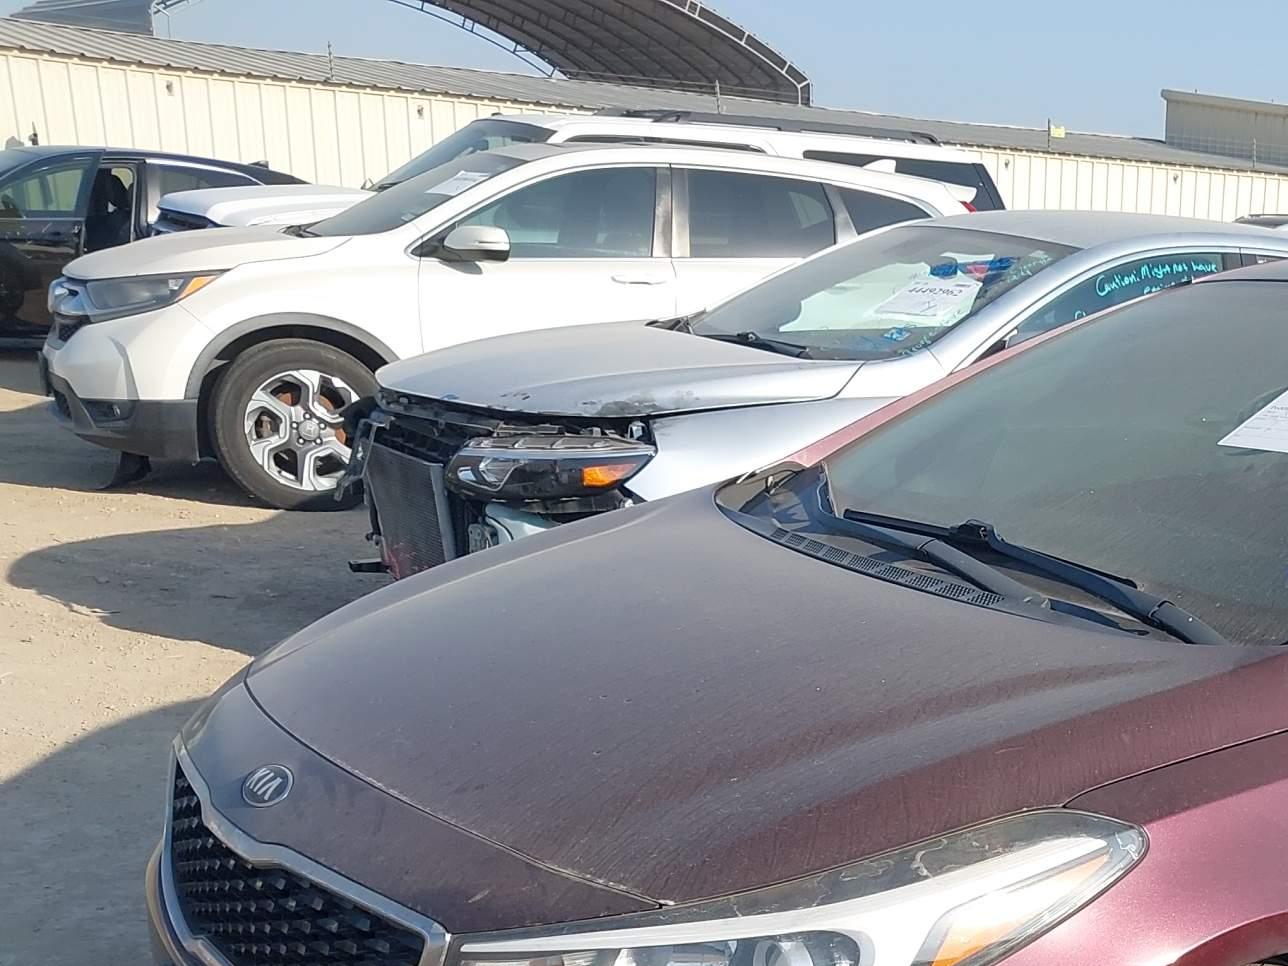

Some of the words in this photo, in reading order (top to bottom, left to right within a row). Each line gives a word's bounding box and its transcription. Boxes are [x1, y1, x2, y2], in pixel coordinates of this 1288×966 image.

[1141, 263, 1171, 279] Might
[1173, 262, 1189, 275] not
[1191, 260, 1217, 273] have
[245, 767, 282, 801] KIA
